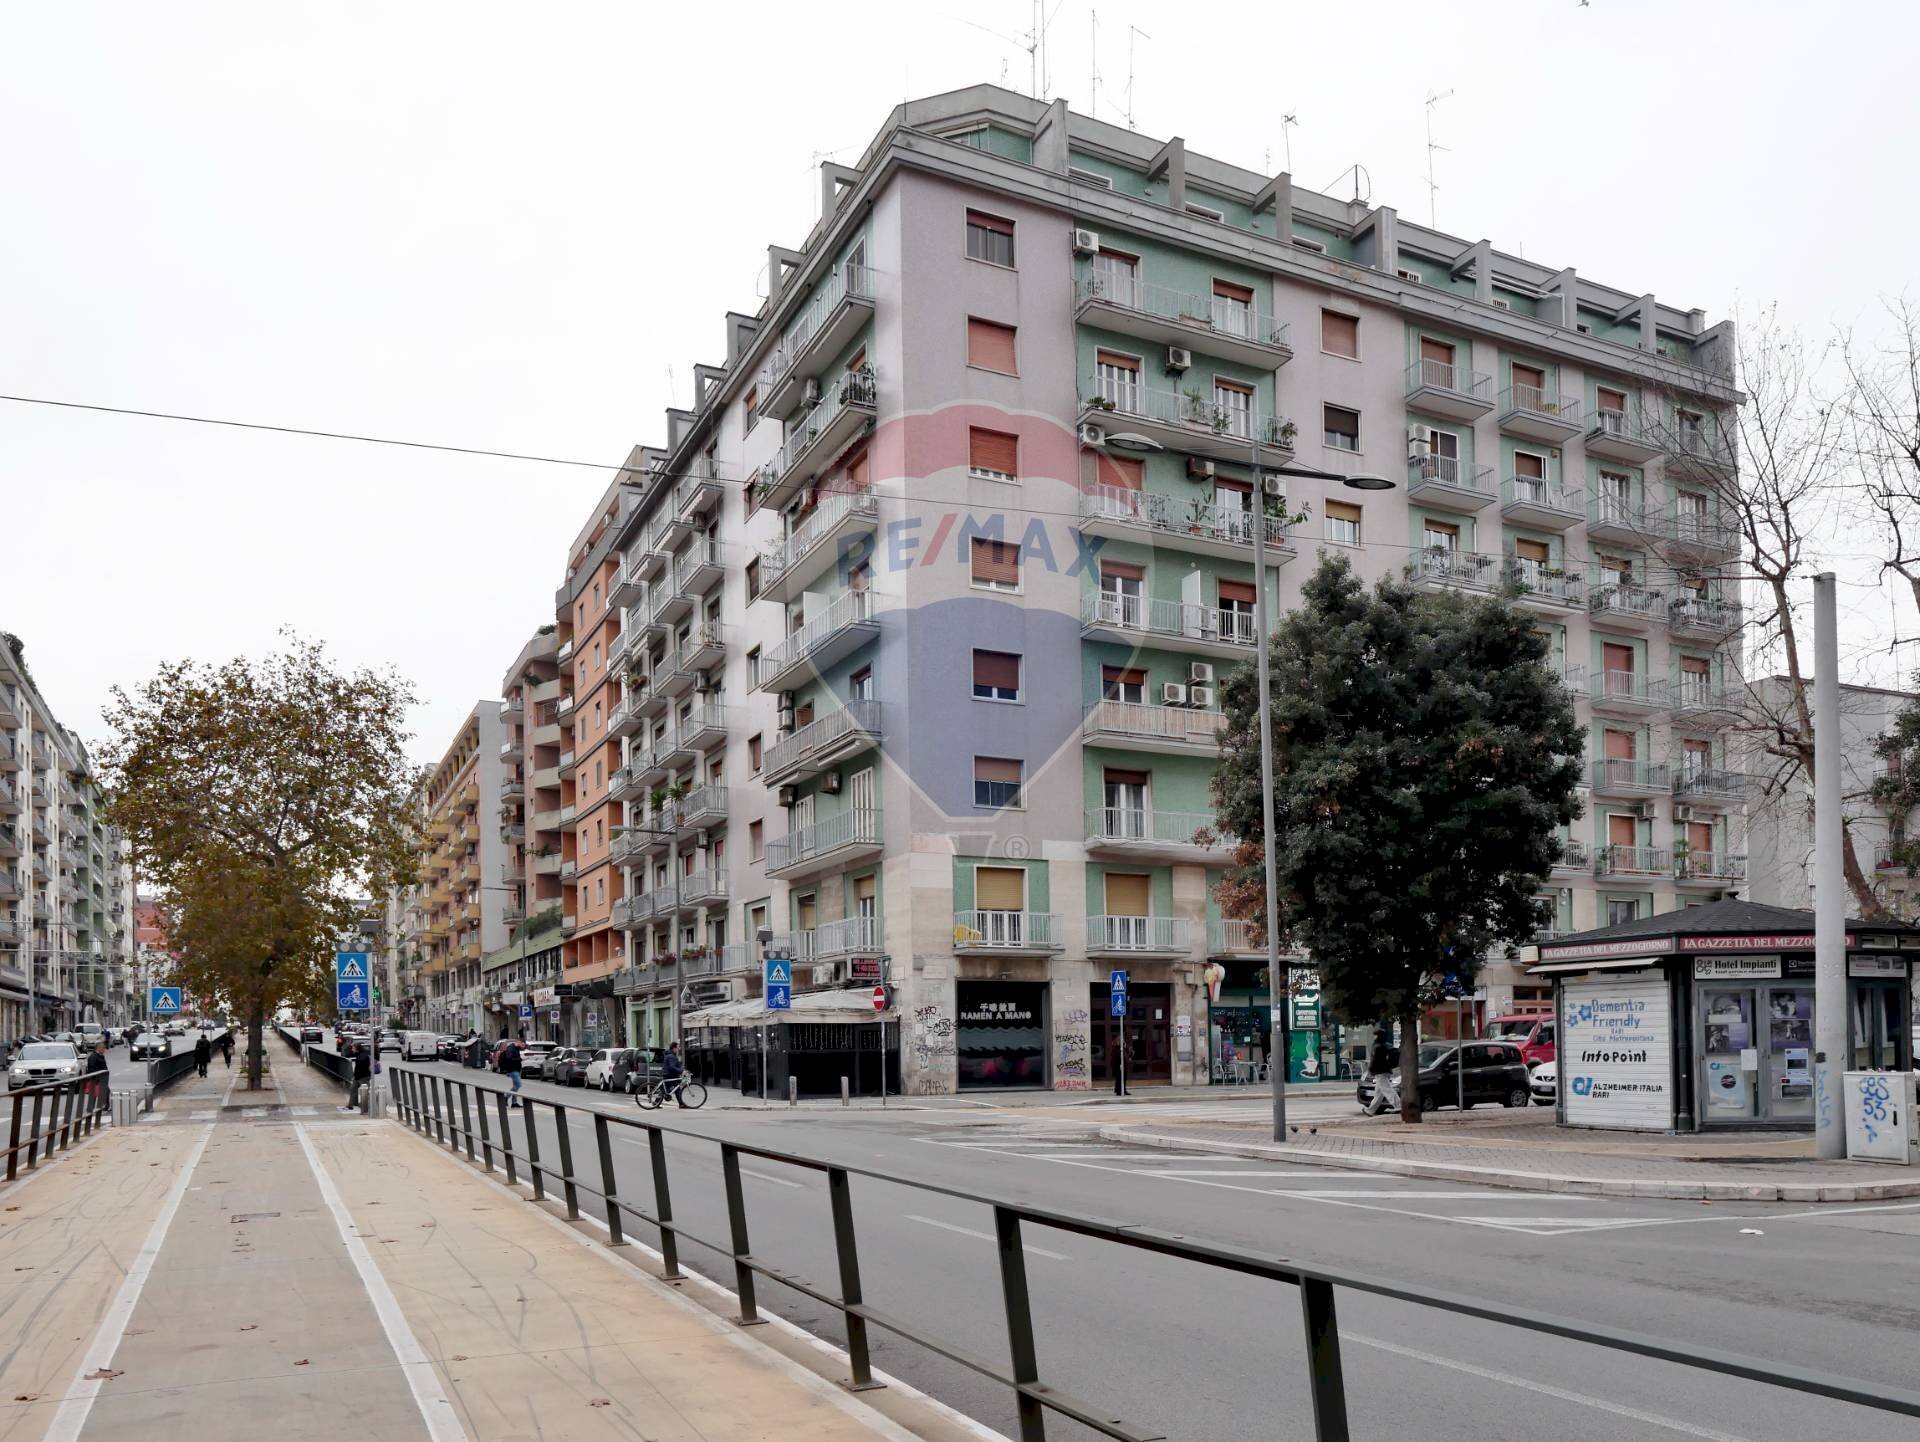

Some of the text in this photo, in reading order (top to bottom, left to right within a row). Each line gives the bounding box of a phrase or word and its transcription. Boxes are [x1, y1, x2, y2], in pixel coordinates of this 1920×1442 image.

[1553, 946, 1592, 957] GAZZETTA
[1592, 945, 1608, 954] DEL
[1609, 940, 1669, 953] MEZZOGIORNO
[1697, 937, 1751, 949] GAZZETTA
[1753, 937, 1773, 948] DEL
[1714, 960, 1738, 969] Hotel
[1740, 959, 1777, 970] Impianti
[1591, 999, 1646, 1012] Dementia
[521, 1007, 530, 1017] P
[960, 1011, 1032, 1020] RAMEN A MANO
[1592, 1014, 1641, 1029] Friendly
[1593, 1083, 1663, 1093] ALZHEIMER ITALIA
[1592, 1091, 1610, 1099] BARI
